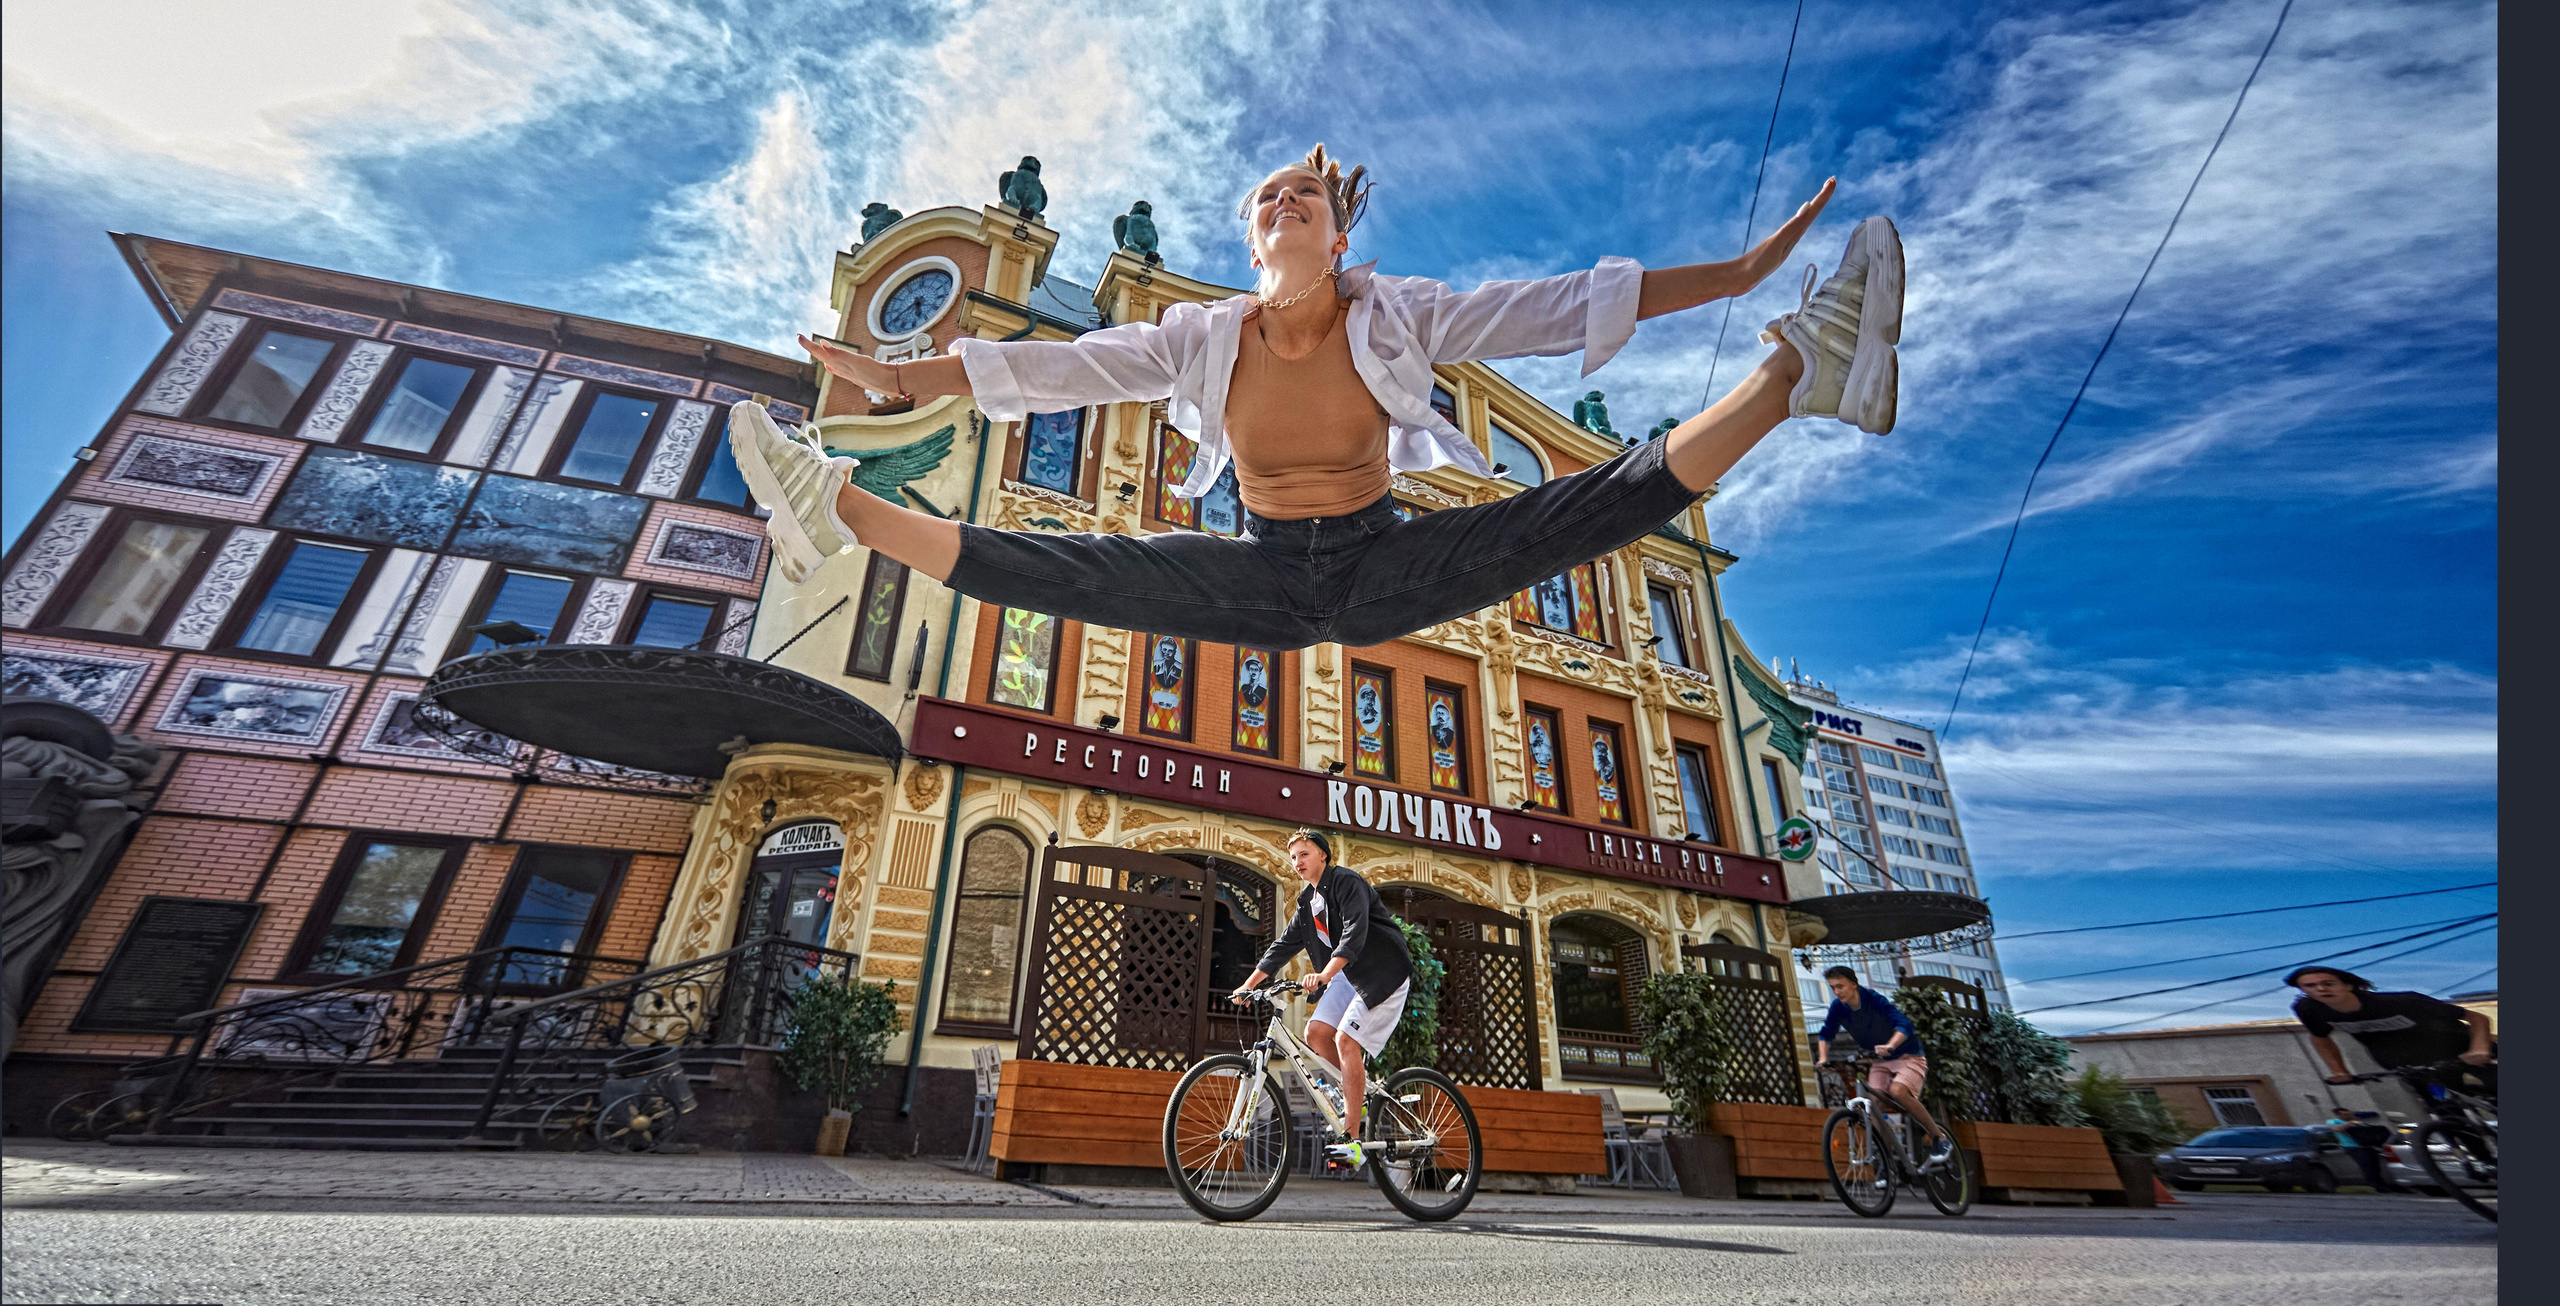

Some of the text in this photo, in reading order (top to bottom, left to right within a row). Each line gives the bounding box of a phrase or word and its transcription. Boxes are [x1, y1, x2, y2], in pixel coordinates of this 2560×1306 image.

[1809, 710, 1863, 736] РИСТ
[1025, 733, 1502, 850] РЕСТОРАН КОЛЧАКЪ
[768, 841, 841, 855] РЕСТОРАНЪ
[780, 825, 831, 846] КОЛЧАКЪ
[1588, 832, 1724, 875] IRISH PUB
